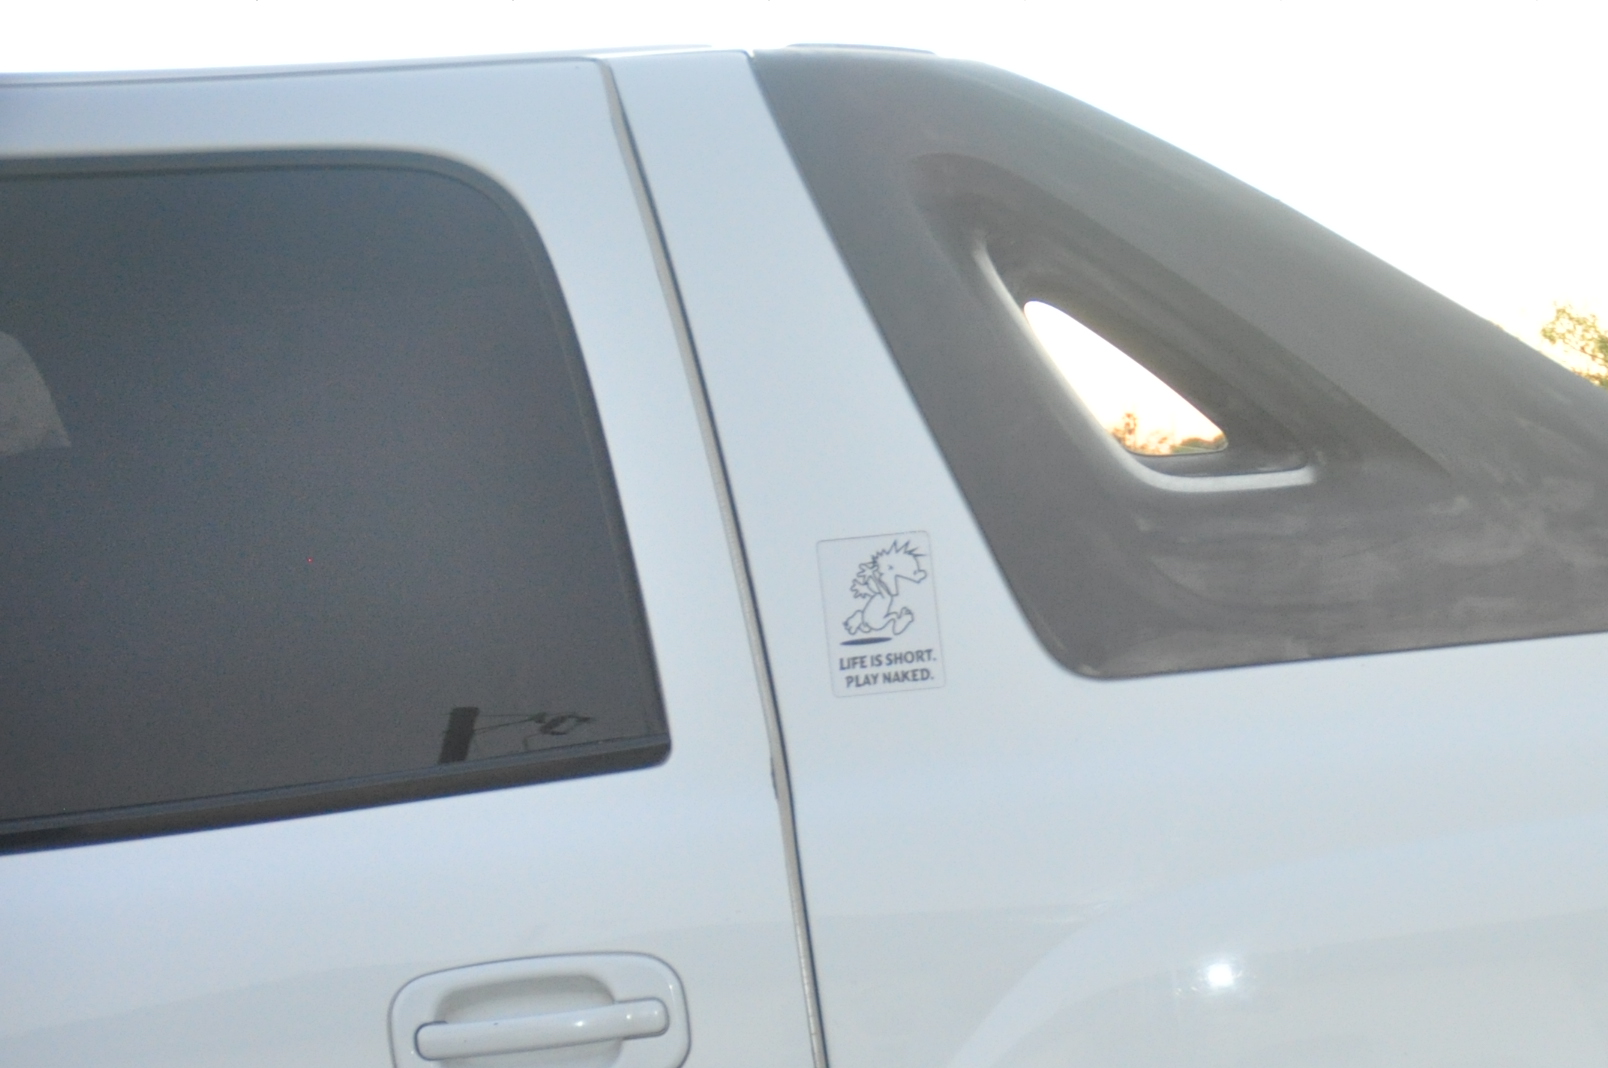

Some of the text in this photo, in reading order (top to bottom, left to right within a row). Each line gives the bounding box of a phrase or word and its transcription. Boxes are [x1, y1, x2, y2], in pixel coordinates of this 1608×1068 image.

[839, 648, 937, 671] LIFE IS SHORT.
[845, 667, 934, 688] PLAY NAKED.
